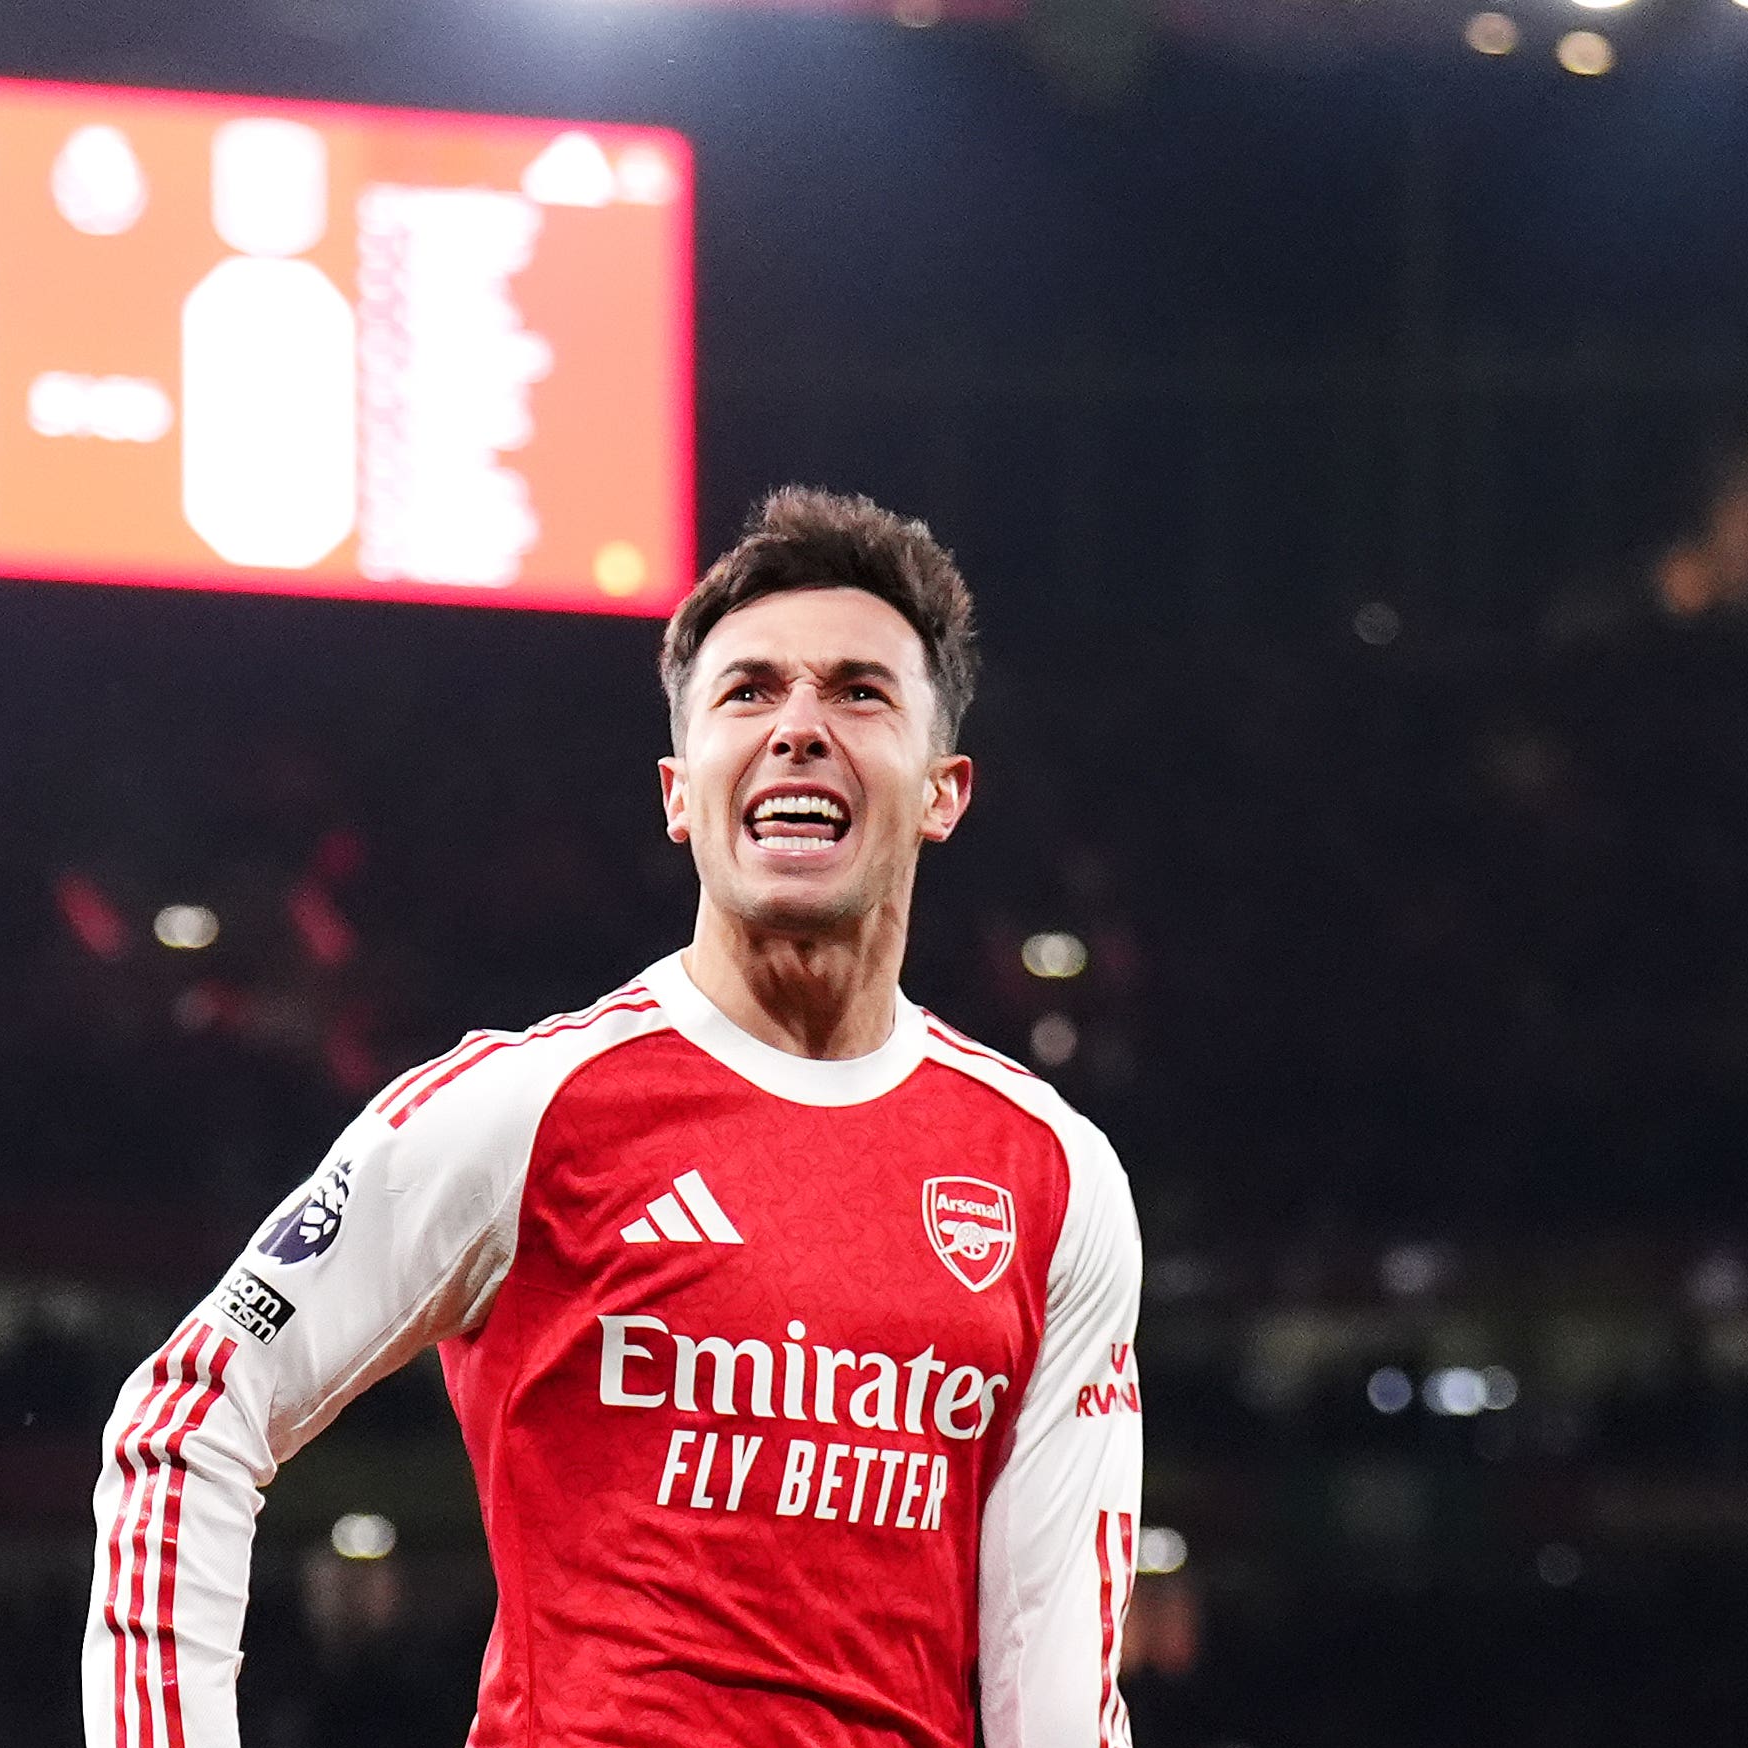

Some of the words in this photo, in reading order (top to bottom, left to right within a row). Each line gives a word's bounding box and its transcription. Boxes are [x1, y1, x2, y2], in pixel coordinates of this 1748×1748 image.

[936, 1193, 1003, 1221] Arsenal
[597, 1314, 1009, 1441] Emirates
[656, 1429, 764, 1512] FLY
[776, 1439, 949, 1531] BETTER
